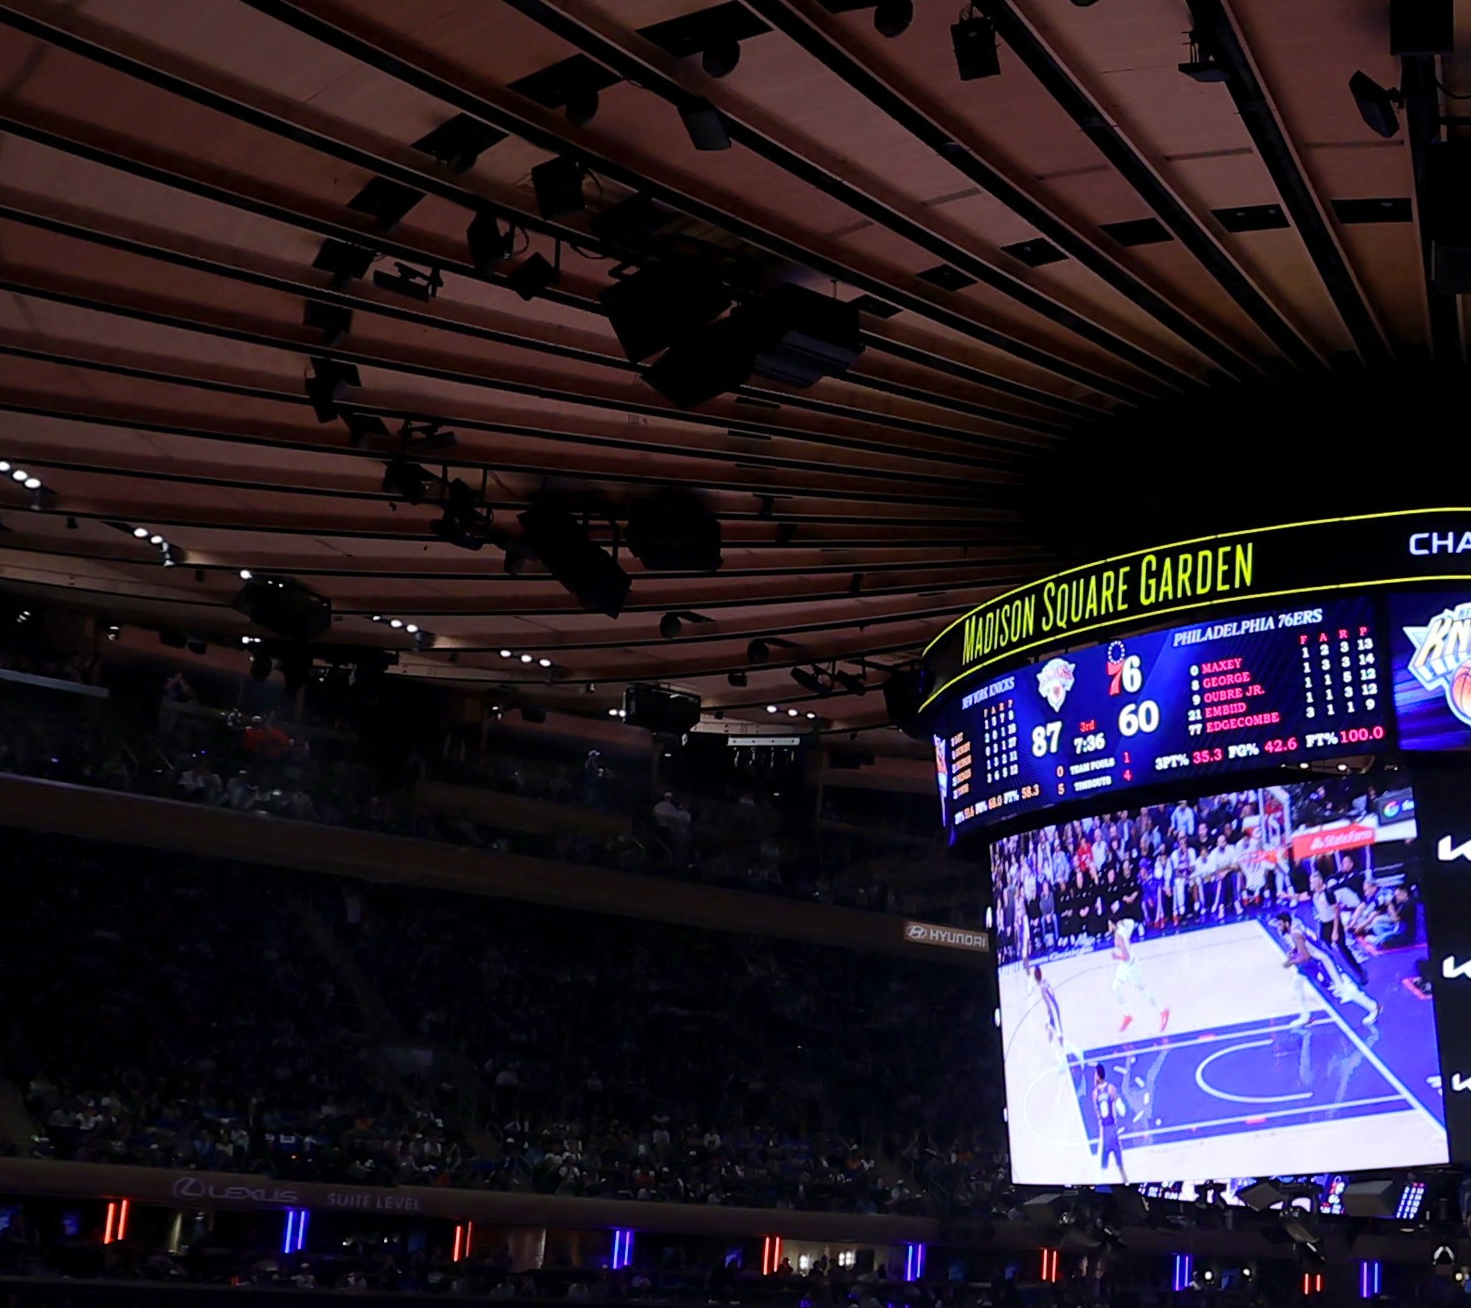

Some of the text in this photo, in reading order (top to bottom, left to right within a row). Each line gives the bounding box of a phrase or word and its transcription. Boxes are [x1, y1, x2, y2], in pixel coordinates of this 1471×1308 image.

[962, 543, 1253, 665] MADISON SQUARE GARDEN
[1173, 609, 1323, 647] PHILADELPHIA 76ERS
[1202, 638, 1373, 674] MAXEY 13
[1203, 653, 1374, 688] GEORGE 14
[1204, 668, 1376, 703] OUBRE JR. 12
[1205, 683, 1377, 718] EMBIID 12
[1080, 720, 1095, 732] 3rd
[1119, 700, 1159, 736] 60
[1206, 712, 1279, 733] EDGECOMBE
[1032, 721, 1062, 757] 87
[1074, 733, 1105, 754] 7:36
[1155, 726, 1384, 770] 3PT% 35.3 FG% 42.6 FT% 100.0
[1070, 758, 1115, 775] TEAM FOULS
[1074, 776, 1112, 791] TIMEOUTS
[930, 929, 985, 948] HYUNDAI
[209, 1185, 298, 1202] LEXUS
[327, 1193, 421, 1211] SUITE LEVEL
